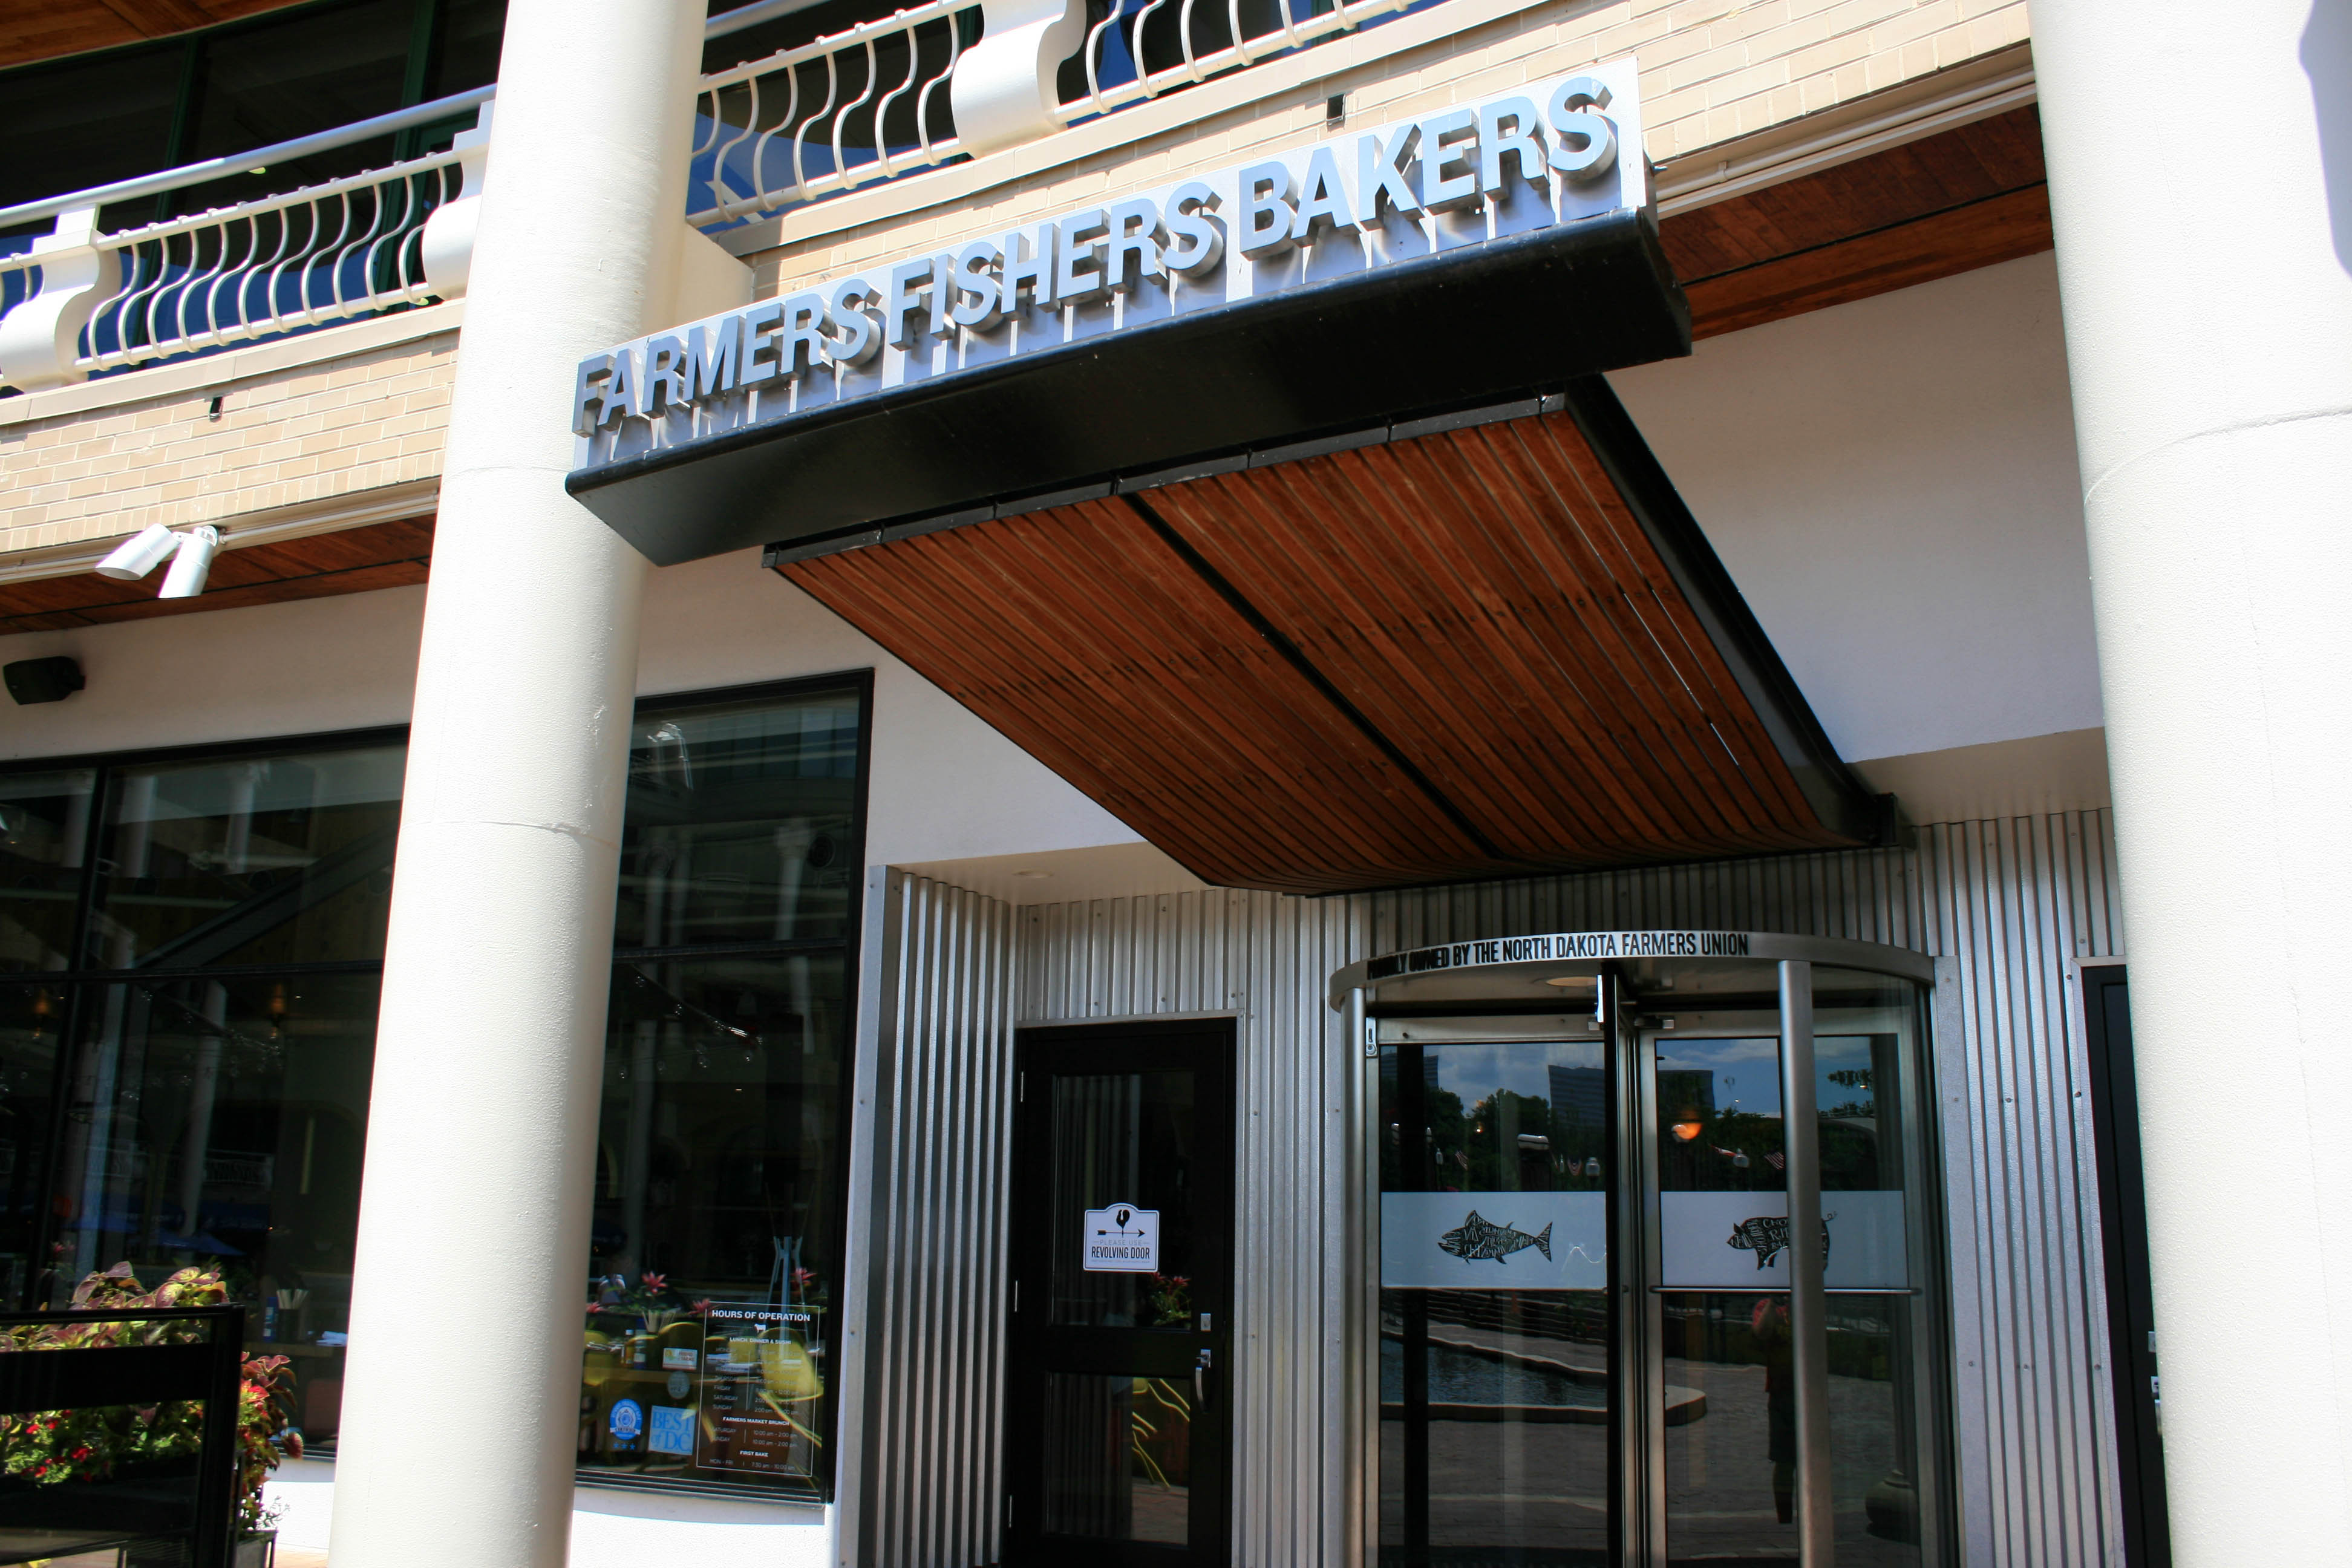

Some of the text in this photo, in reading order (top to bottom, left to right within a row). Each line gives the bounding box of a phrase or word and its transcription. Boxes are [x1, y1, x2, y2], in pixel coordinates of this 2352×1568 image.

[572, 76, 1617, 437] FARMERS FISHERS BAKERS
[1453, 944, 1471, 966] BY
[1473, 941, 1499, 964] THE
[1503, 938, 1550, 961] NORTH
[1556, 934, 1617, 958] DAKOTA
[1622, 933, 1694, 956] FARMERS
[1701, 933, 1749, 955] UNION
[1091, 1246, 1150, 1259] REVOLVING DOOR
[712, 1310, 743, 1318] HOURS
[759, 1312, 811, 1321] OPERATION
[653, 1411, 693, 1432] BEST
